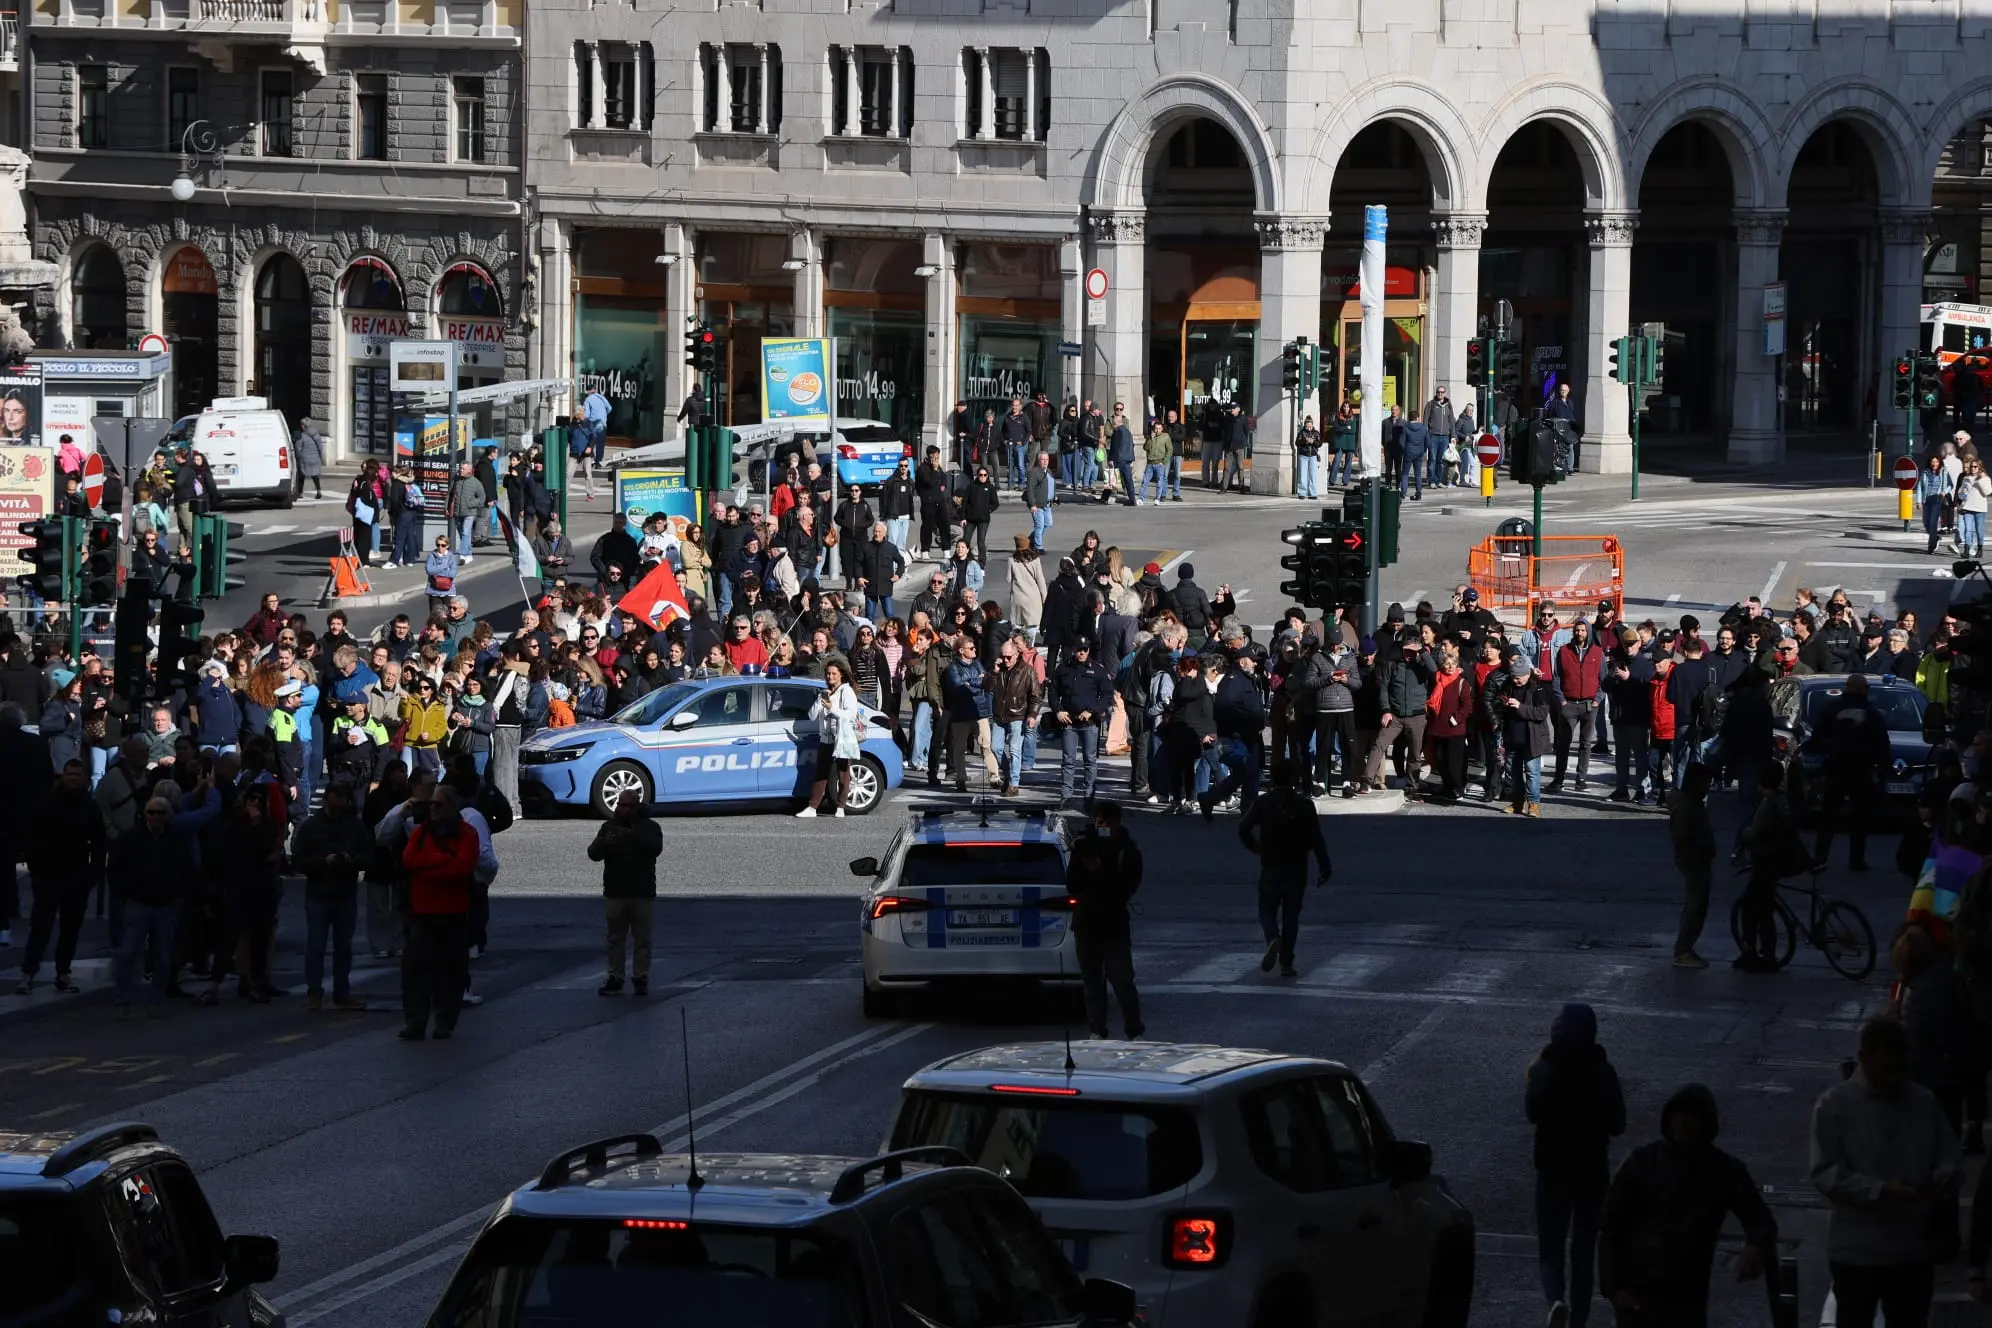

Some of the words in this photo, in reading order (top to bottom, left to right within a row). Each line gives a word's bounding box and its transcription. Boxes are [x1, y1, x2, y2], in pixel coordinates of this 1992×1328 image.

[351, 316, 409, 337] RE/MAX
[1948, 312, 1986, 323] AMBULANZA
[448, 323, 505, 343] RE/MAX
[458, 343, 496, 352] ENTERPRISE
[78, 363, 89, 373] IL
[91, 363, 134, 373] PICCOLO
[608, 369, 637, 400] 14,99
[864, 370, 895, 400] 14,99
[968, 376, 998, 398] TUTTO
[999, 369, 1031, 400] 14,99
[635, 477, 680, 489] ORIGINALE
